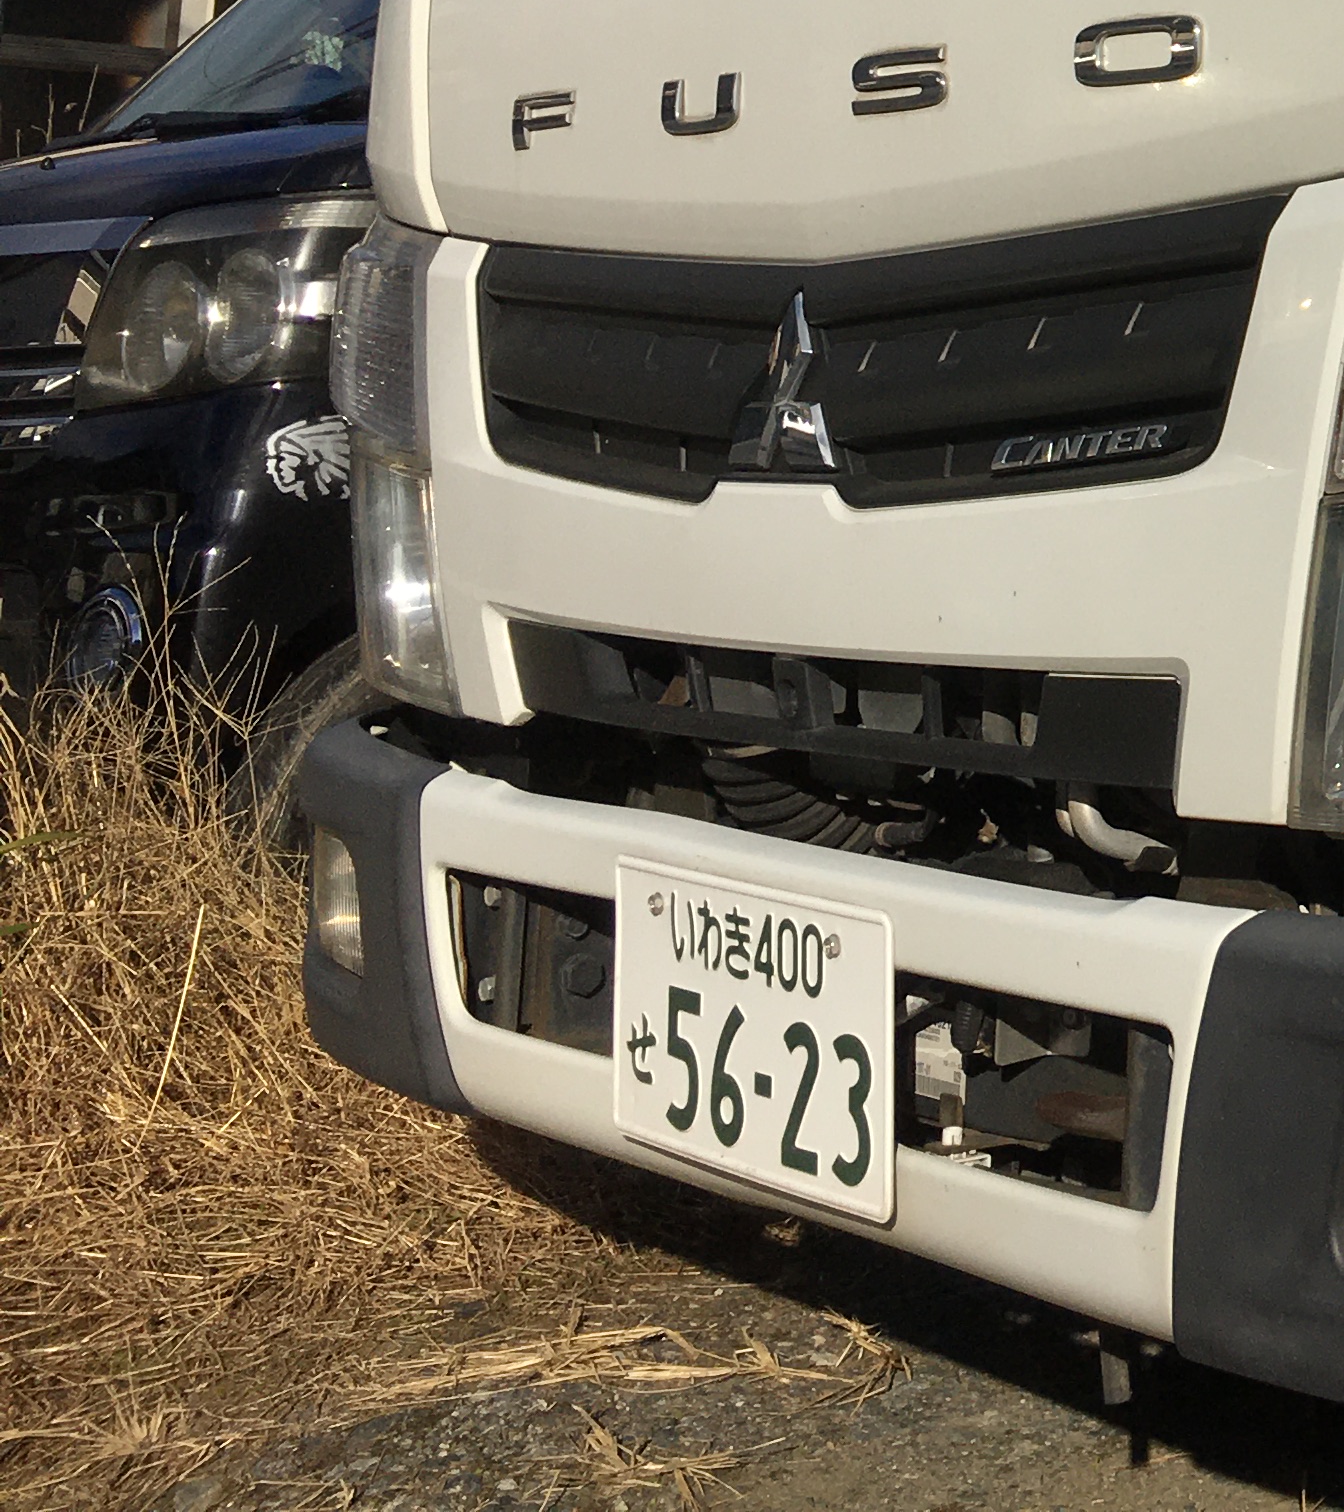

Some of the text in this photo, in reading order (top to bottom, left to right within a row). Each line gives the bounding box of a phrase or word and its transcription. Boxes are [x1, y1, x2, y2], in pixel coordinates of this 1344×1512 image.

[512, 13, 1202, 151] FUSO
[991, 424, 1168, 471] CANTER
[665, 985, 872, 1186] 56-23
